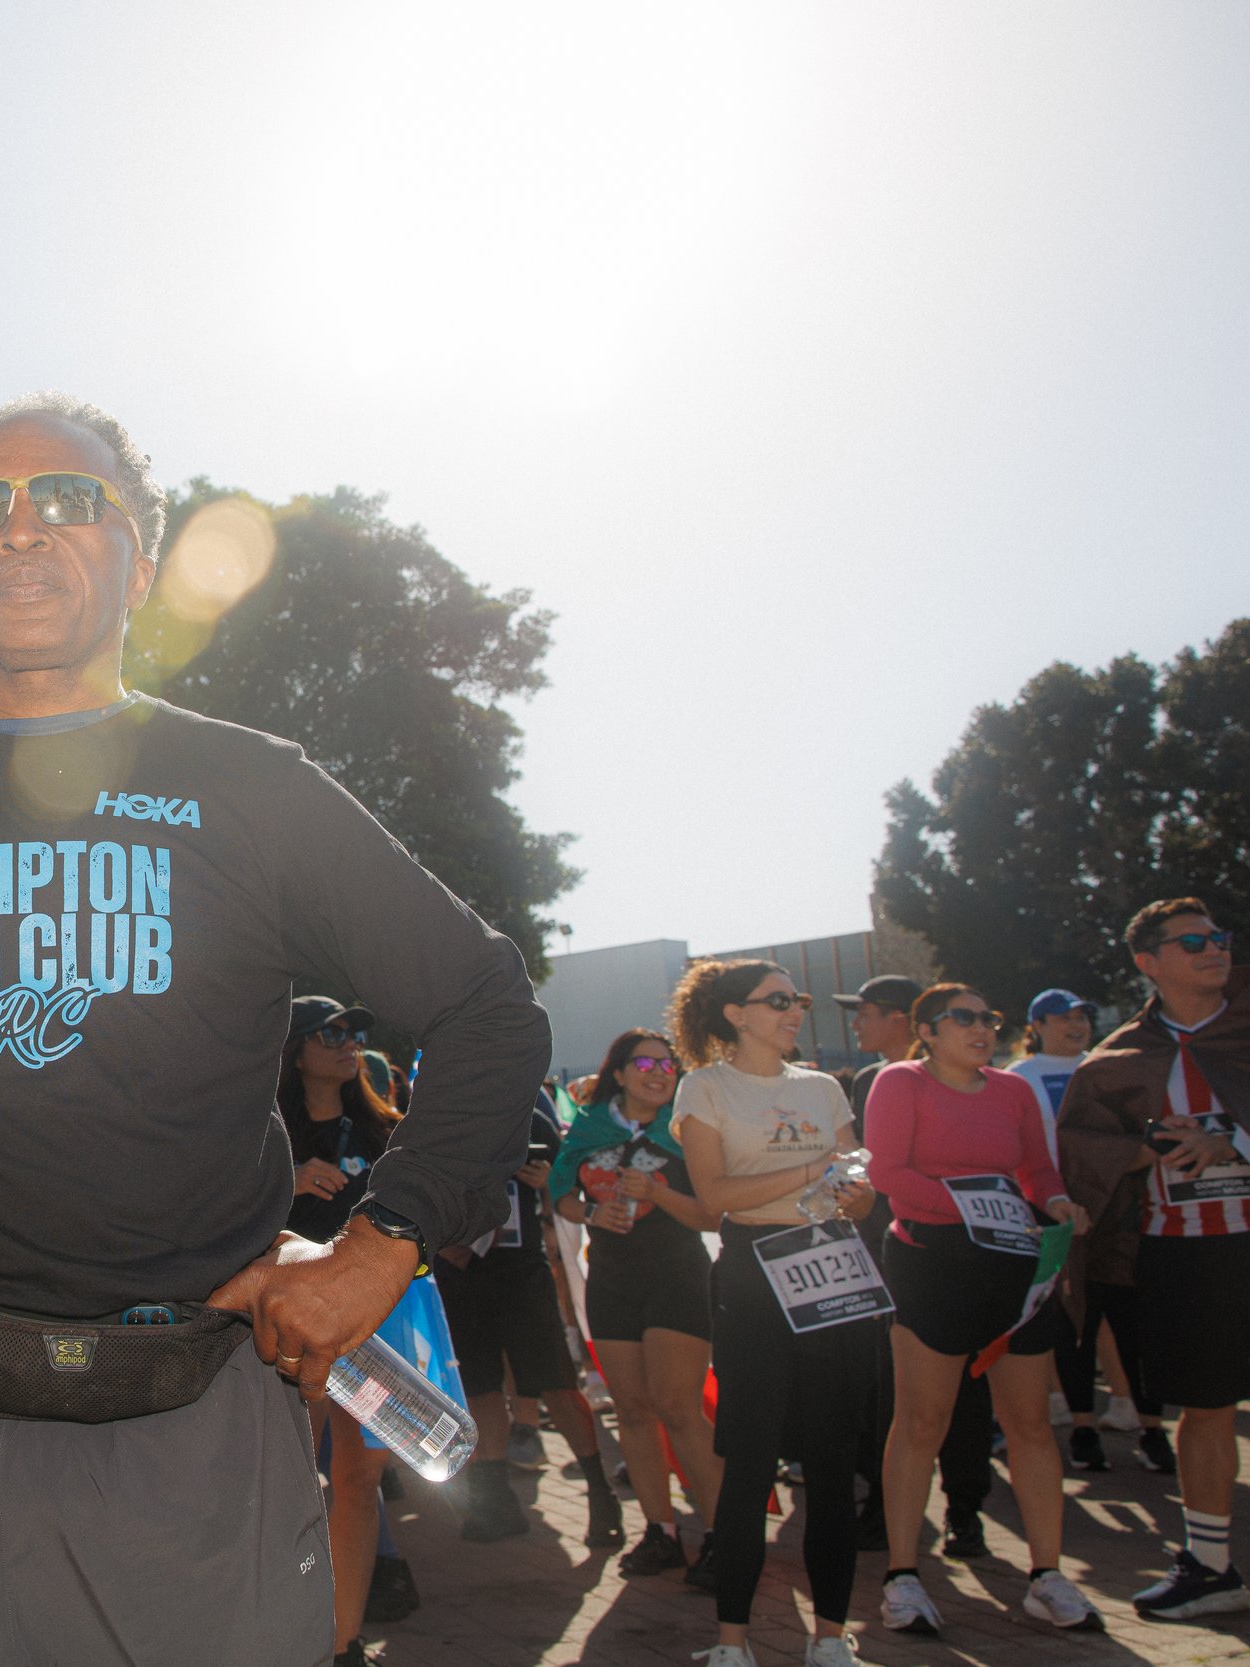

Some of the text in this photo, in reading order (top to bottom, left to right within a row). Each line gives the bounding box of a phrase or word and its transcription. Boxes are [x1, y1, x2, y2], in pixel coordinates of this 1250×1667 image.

[94, 790, 202, 829] HOKA
[18, 912, 173, 995] CLUB
[785, 1249, 871, 1294] 90220
[55, 1354, 86, 1366] amphipod
